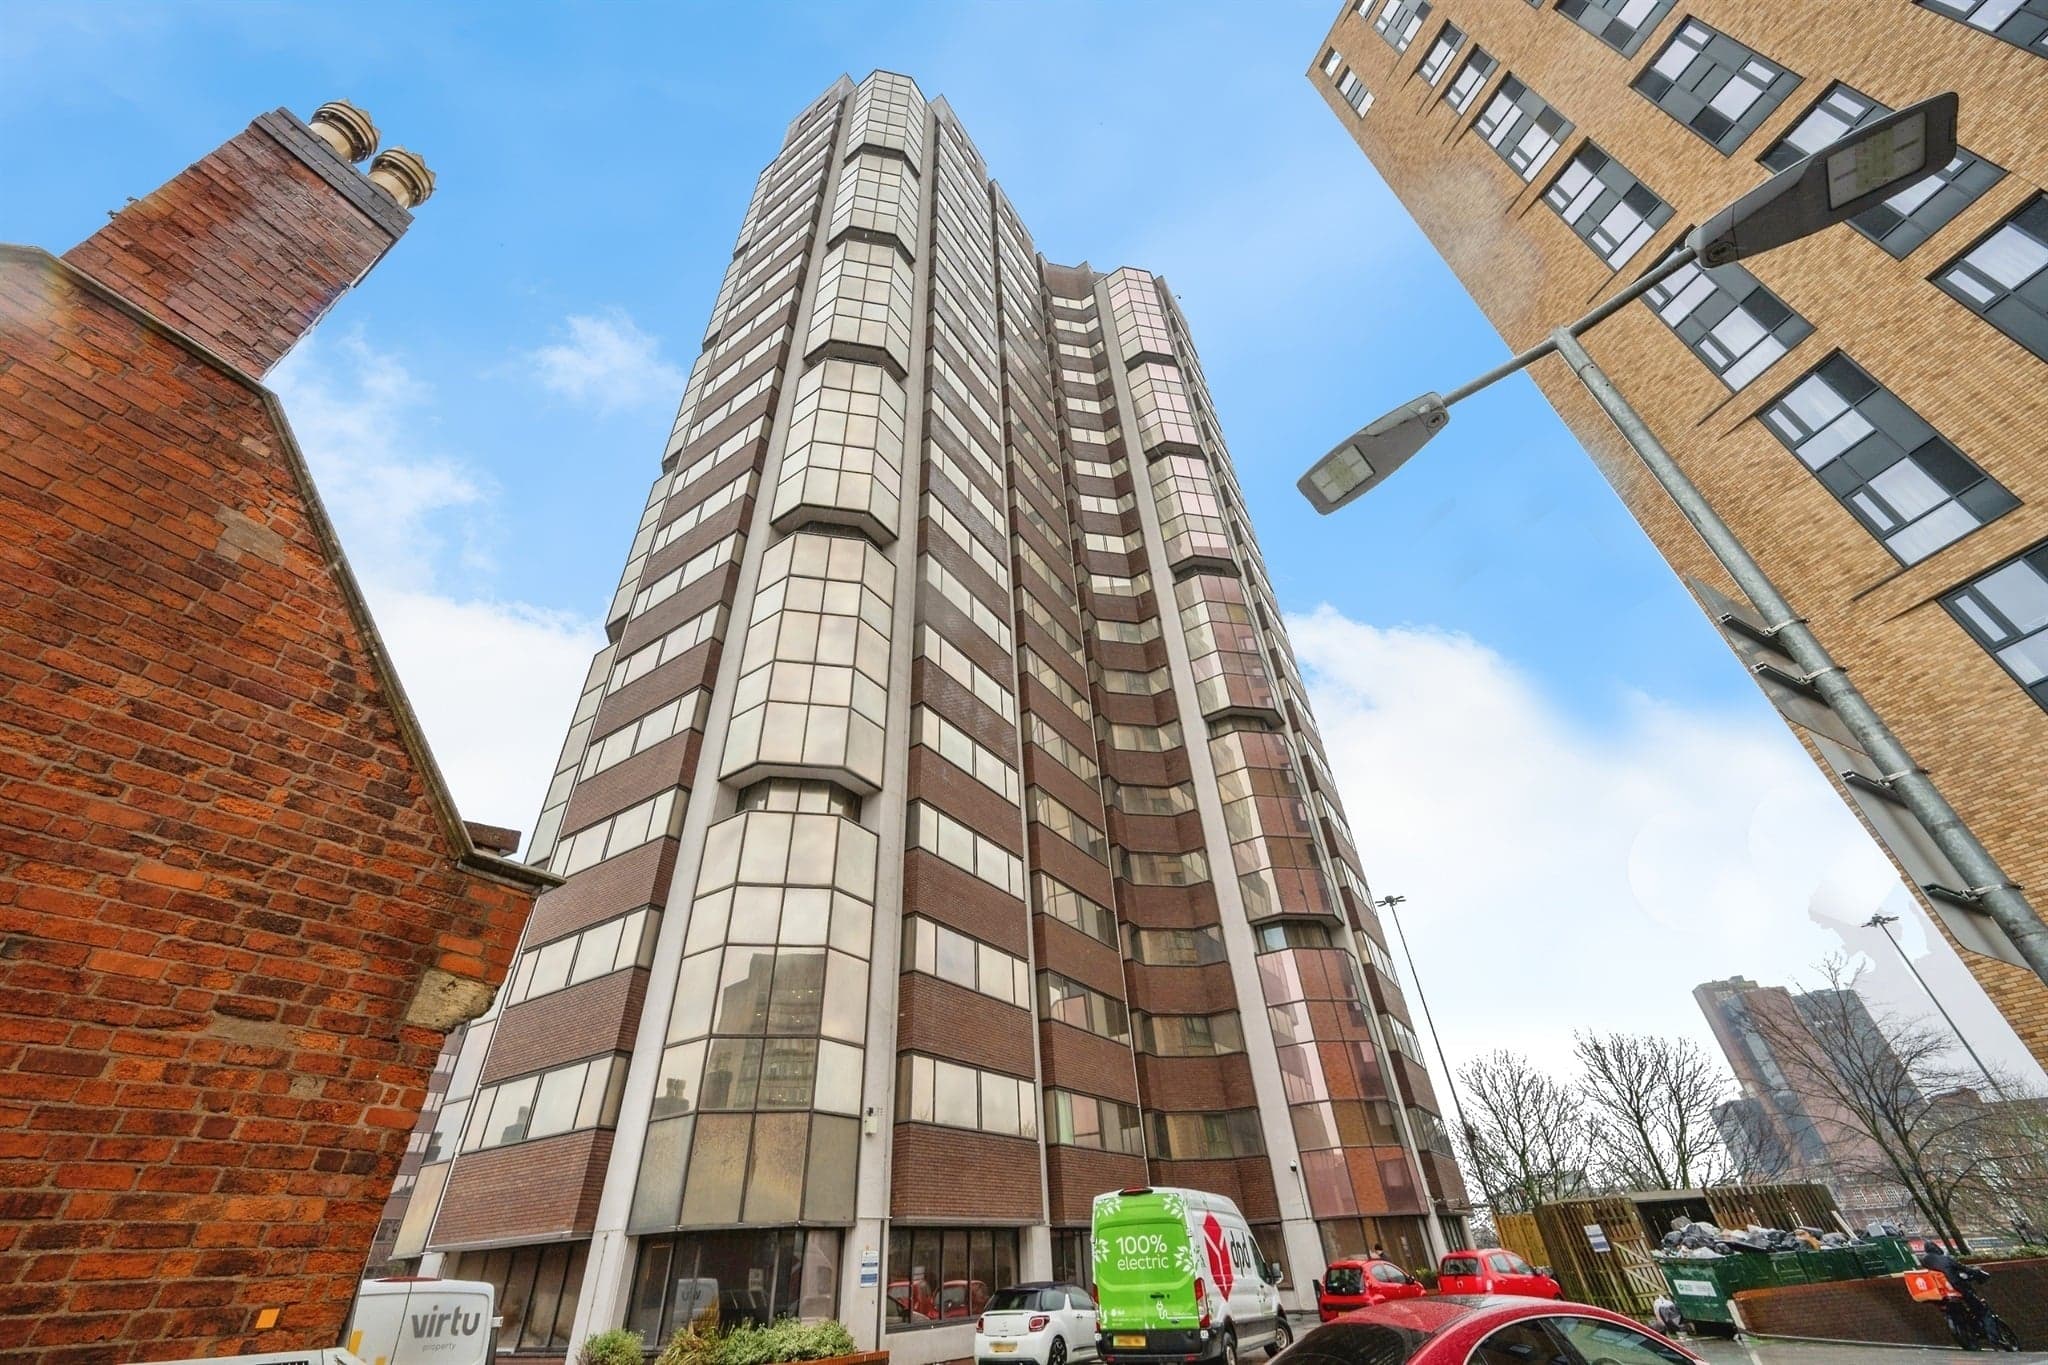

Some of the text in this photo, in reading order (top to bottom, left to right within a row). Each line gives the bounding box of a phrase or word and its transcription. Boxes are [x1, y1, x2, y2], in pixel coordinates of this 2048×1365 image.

[1116, 1234, 1168, 1255] 100%
[1230, 1230, 1251, 1278] dpd
[1117, 1255, 1169, 1270] electric
[411, 1304, 480, 1338] virtu
